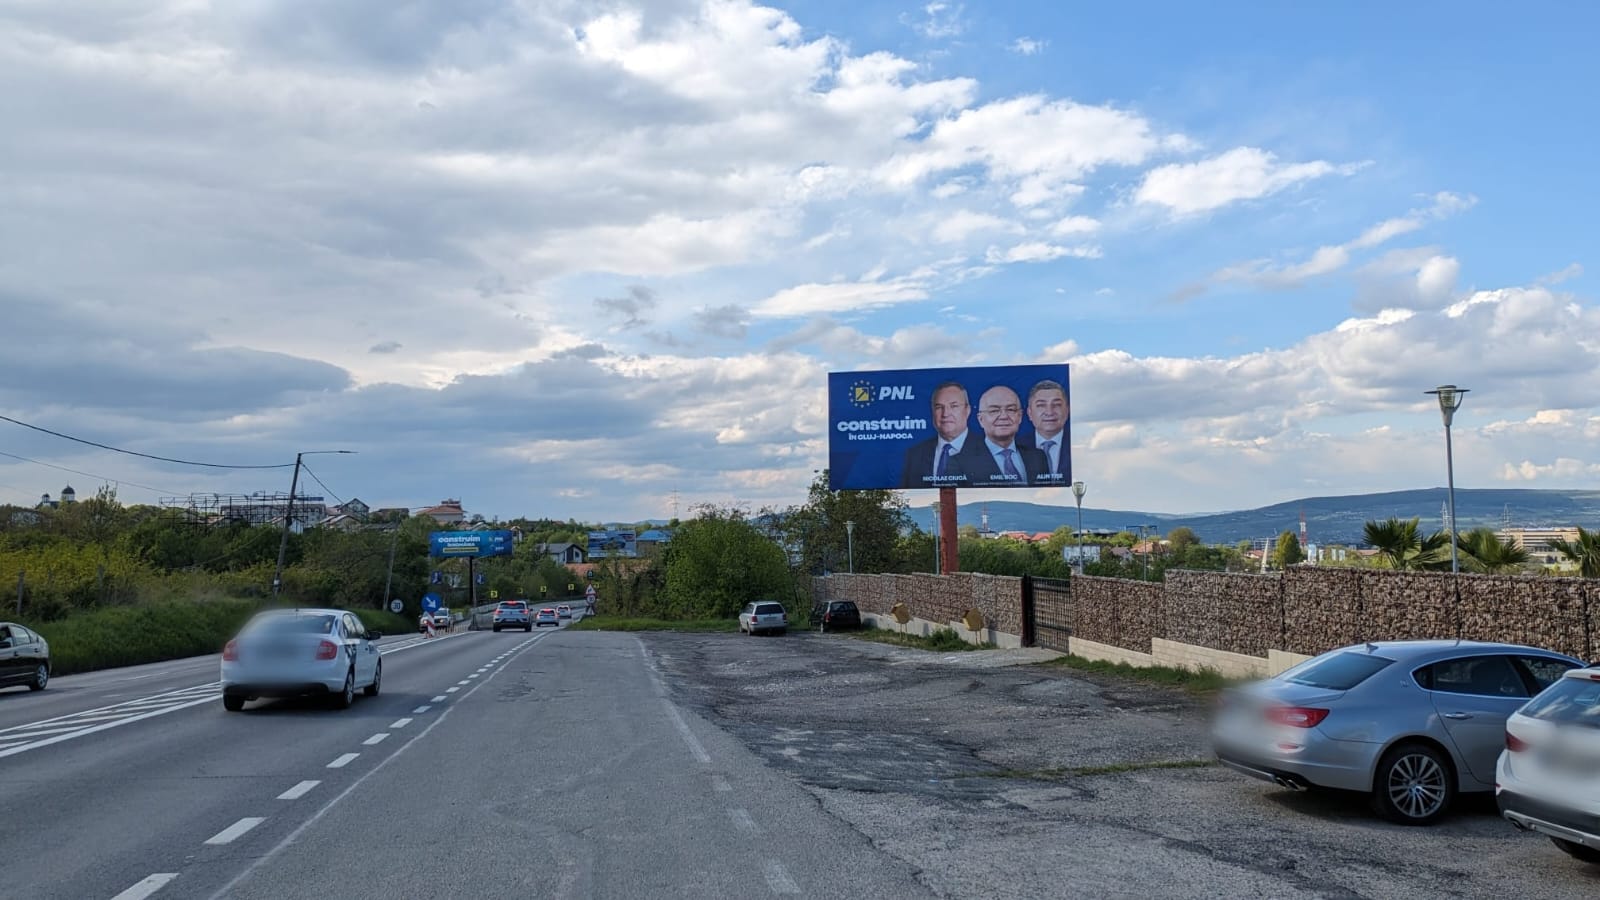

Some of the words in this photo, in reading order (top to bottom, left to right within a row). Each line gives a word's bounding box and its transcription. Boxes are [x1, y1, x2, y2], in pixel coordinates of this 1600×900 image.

[878, 386, 915, 400] PNL
[837, 416, 927, 432] construim
[438, 535, 481, 543] construim
